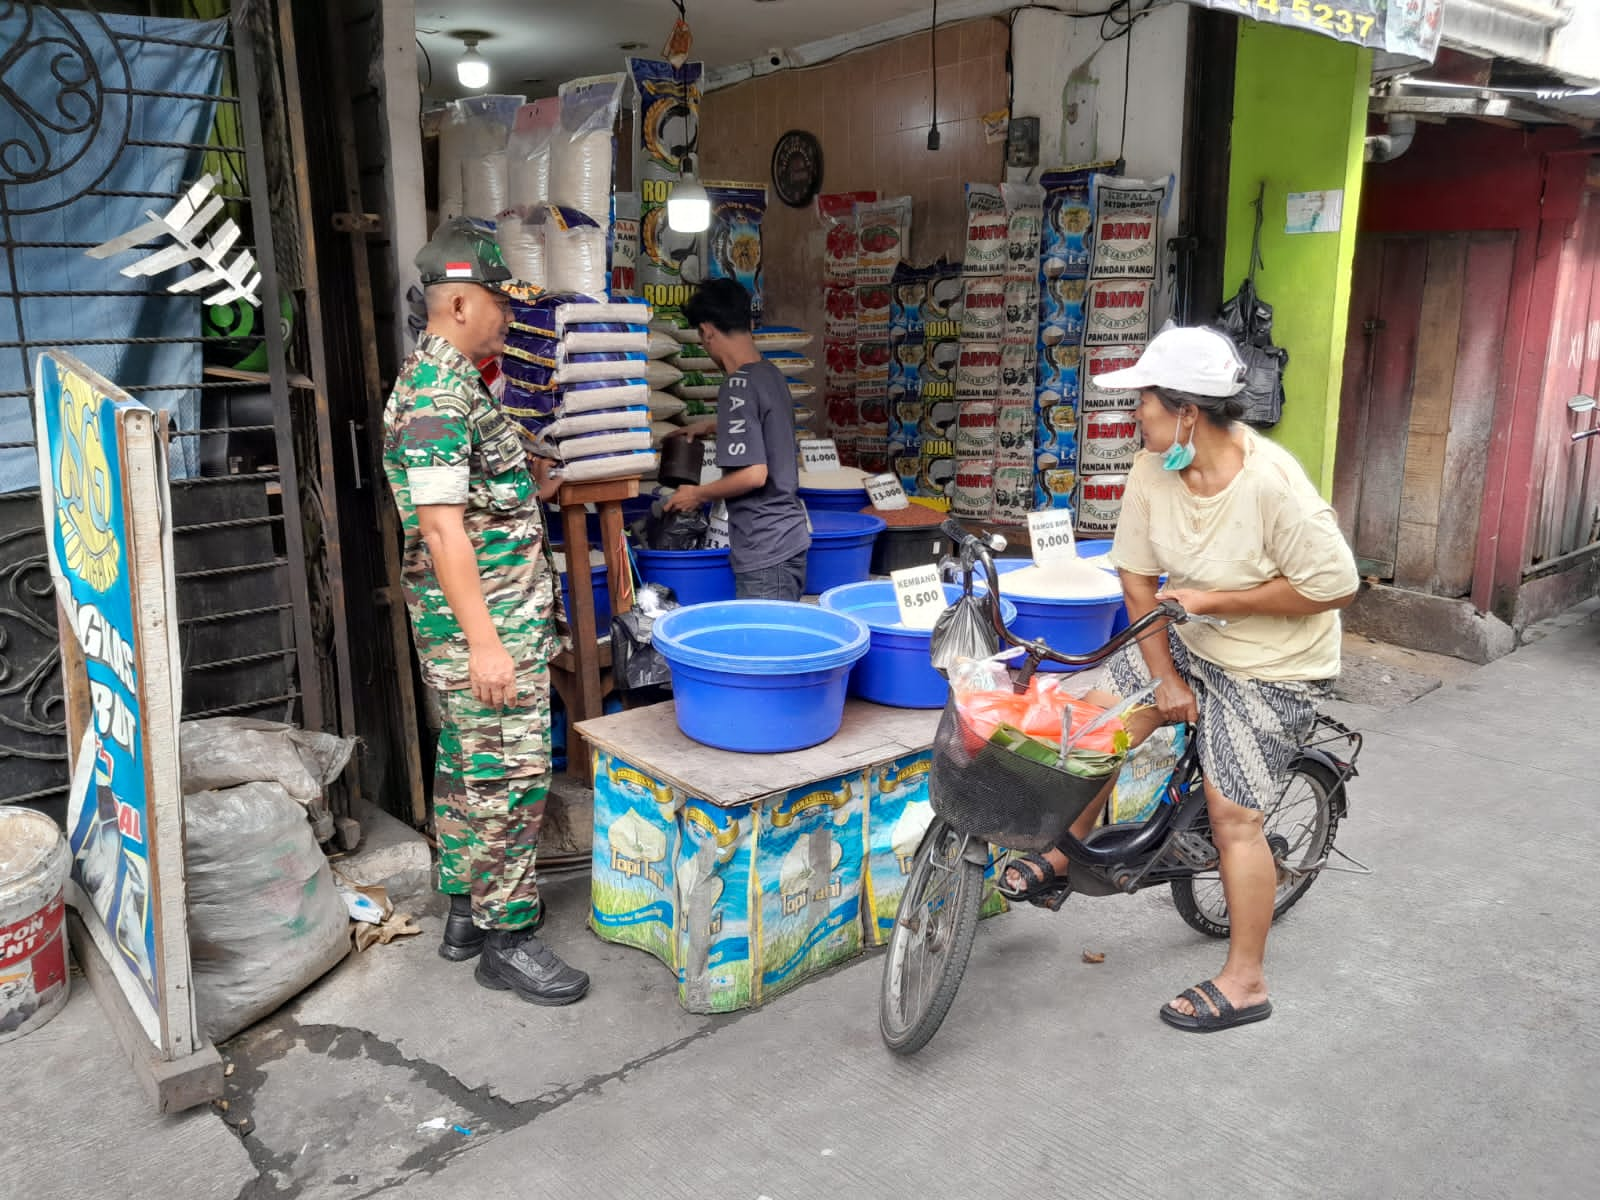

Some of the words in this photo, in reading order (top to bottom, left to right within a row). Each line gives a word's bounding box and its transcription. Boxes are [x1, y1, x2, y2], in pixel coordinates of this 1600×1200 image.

[1292, 0, 1375, 38] 5237
[1101, 223, 1151, 240] BMW
[1094, 264, 1126, 275] PANDAN
[1127, 264, 1153, 274] WANGI
[1094, 291, 1145, 309] BMW
[1088, 332, 1118, 342] PANDAN
[1085, 399, 1114, 409] PANDAN
[1116, 398, 1136, 409] WAN
[727, 370, 748, 457] EANS
[1087, 423, 1137, 440] BMW
[1081, 463, 1112, 473] PANDAN
[1079, 522, 1109, 531] PANDAN
[1036, 533, 1070, 552] 9.000
[897, 573, 937, 589] KEMBANG
[903, 590, 939, 609] 8.500
[609, 846, 641, 880] Topi
[781, 887, 808, 918] Topi
